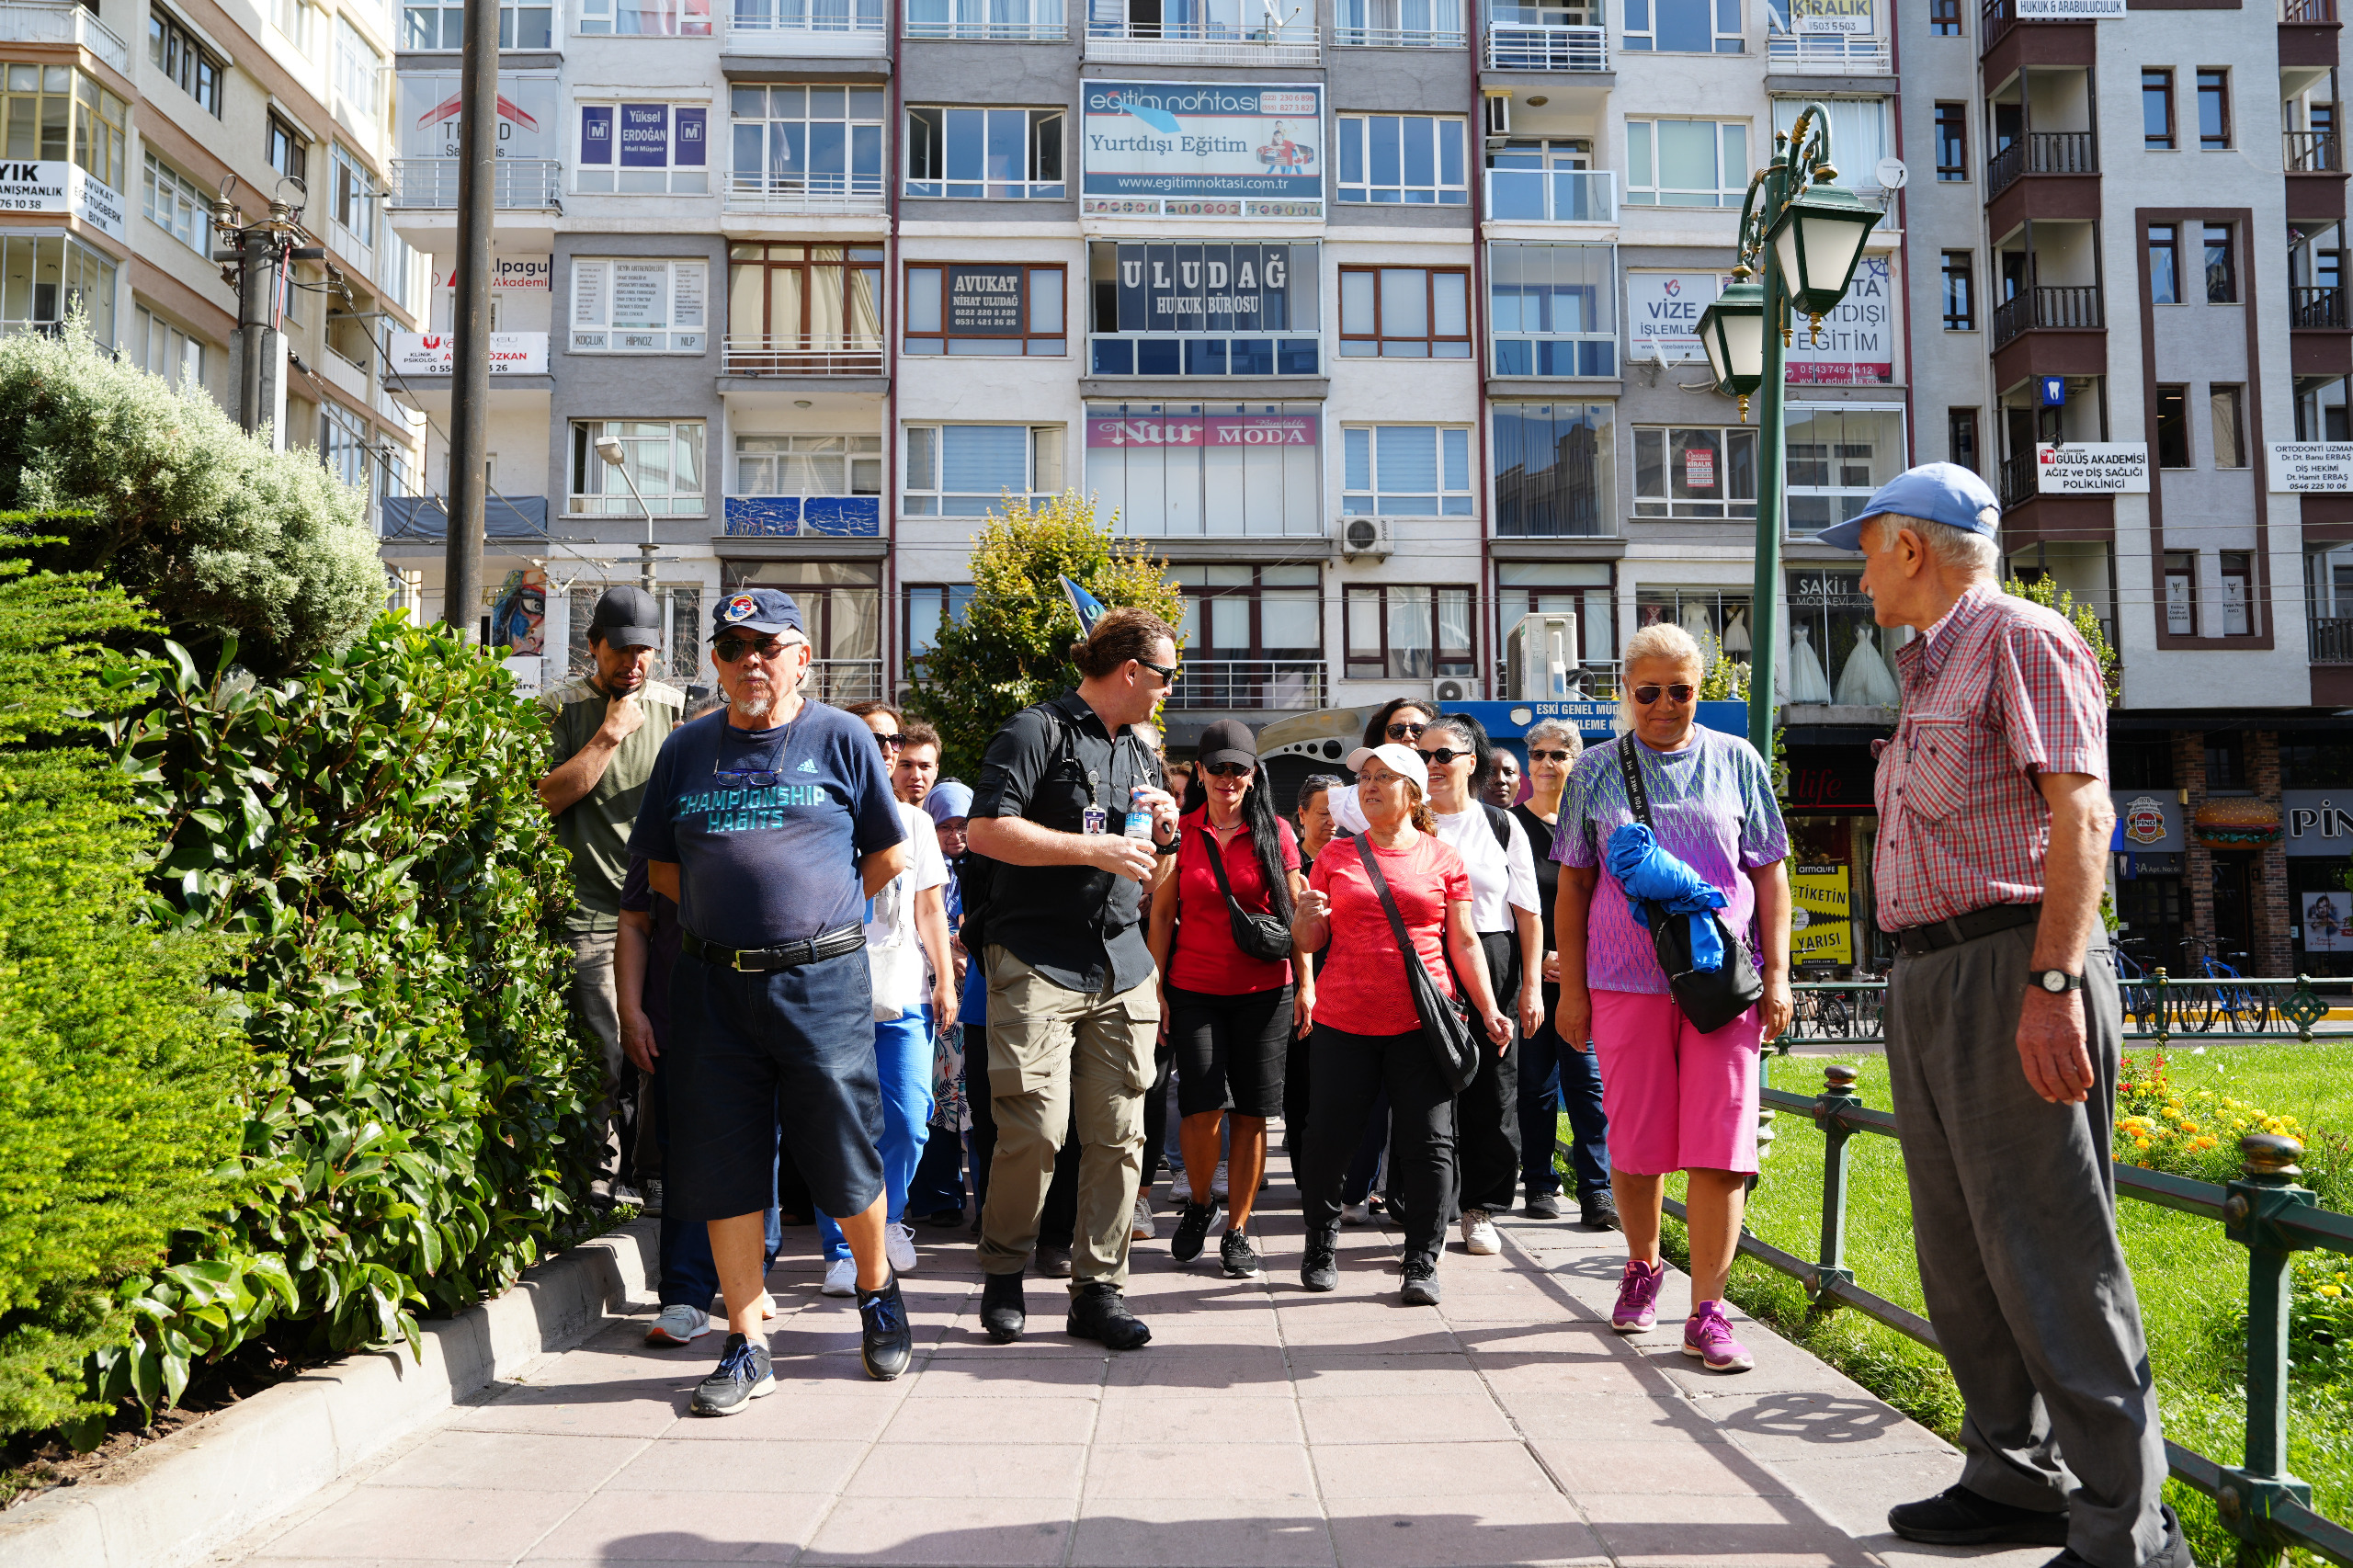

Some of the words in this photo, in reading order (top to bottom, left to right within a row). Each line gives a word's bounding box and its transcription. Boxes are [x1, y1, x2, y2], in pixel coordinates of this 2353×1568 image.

[2059, 1, 2122, 13] ARABULUCULUK
[1165, 91, 1258, 111] noktası
[629, 110, 661, 123] Yüksel
[622, 127, 665, 142] ERDOĞAN
[1090, 134, 1174, 155] Yurtdışı
[1180, 137, 1248, 156] Eğitim
[85, 177, 114, 203] AVUKAT
[1118, 176, 1289, 190] www.egitimnoktasi.com.tr
[16, 199, 26, 209] 10
[28, 200, 41, 210] 38
[89, 195, 122, 224] TUĞBERK
[88, 210, 108, 231] BIYIK
[492, 258, 548, 276] lpagu
[1122, 254, 1286, 289] ULUDAĞ
[493, 277, 548, 288] Akademi
[954, 275, 1017, 292] AVUKAT
[952, 294, 982, 306] NİHAT
[983, 294, 1018, 307] ULUDAĞ
[1156, 296, 1203, 314] HUKUK
[1207, 292, 1259, 314] BÜROSU
[1647, 298, 1697, 319] VİZE
[1641, 322, 1696, 336] İŞLEMLE
[575, 335, 604, 347] KOÇLUK
[626, 335, 653, 347] HİPNOZ
[680, 336, 696, 347] NLP
[1798, 328, 1878, 351] EĞİTİM
[489, 350, 528, 360] ÖZKAN
[495, 364, 508, 372] 26
[1098, 420, 1204, 445] Nur
[1218, 429, 1307, 443] MODA
[2056, 452, 2088, 465] GÜLÜŞ
[2091, 452, 2146, 464] AKADEMİSİ
[2045, 466, 2069, 477] AĞIZ
[2086, 467, 2102, 478] DİŞ
[2105, 466, 2143, 477] SAĞLIĞI
[2295, 464, 2309, 472] DİŞ
[2311, 464, 2339, 472] HEKİMİ
[1799, 576, 1838, 595] SAKİ
[1796, 596, 1849, 607] MODAEVİ
[1537, 702, 1559, 715] ESKİ
[1561, 704, 1594, 715] GENEL
[678, 786, 826, 817] CHAMPIONSHIP
[706, 809, 784, 833] HABITS
[1797, 932, 1841, 949] YARISI
